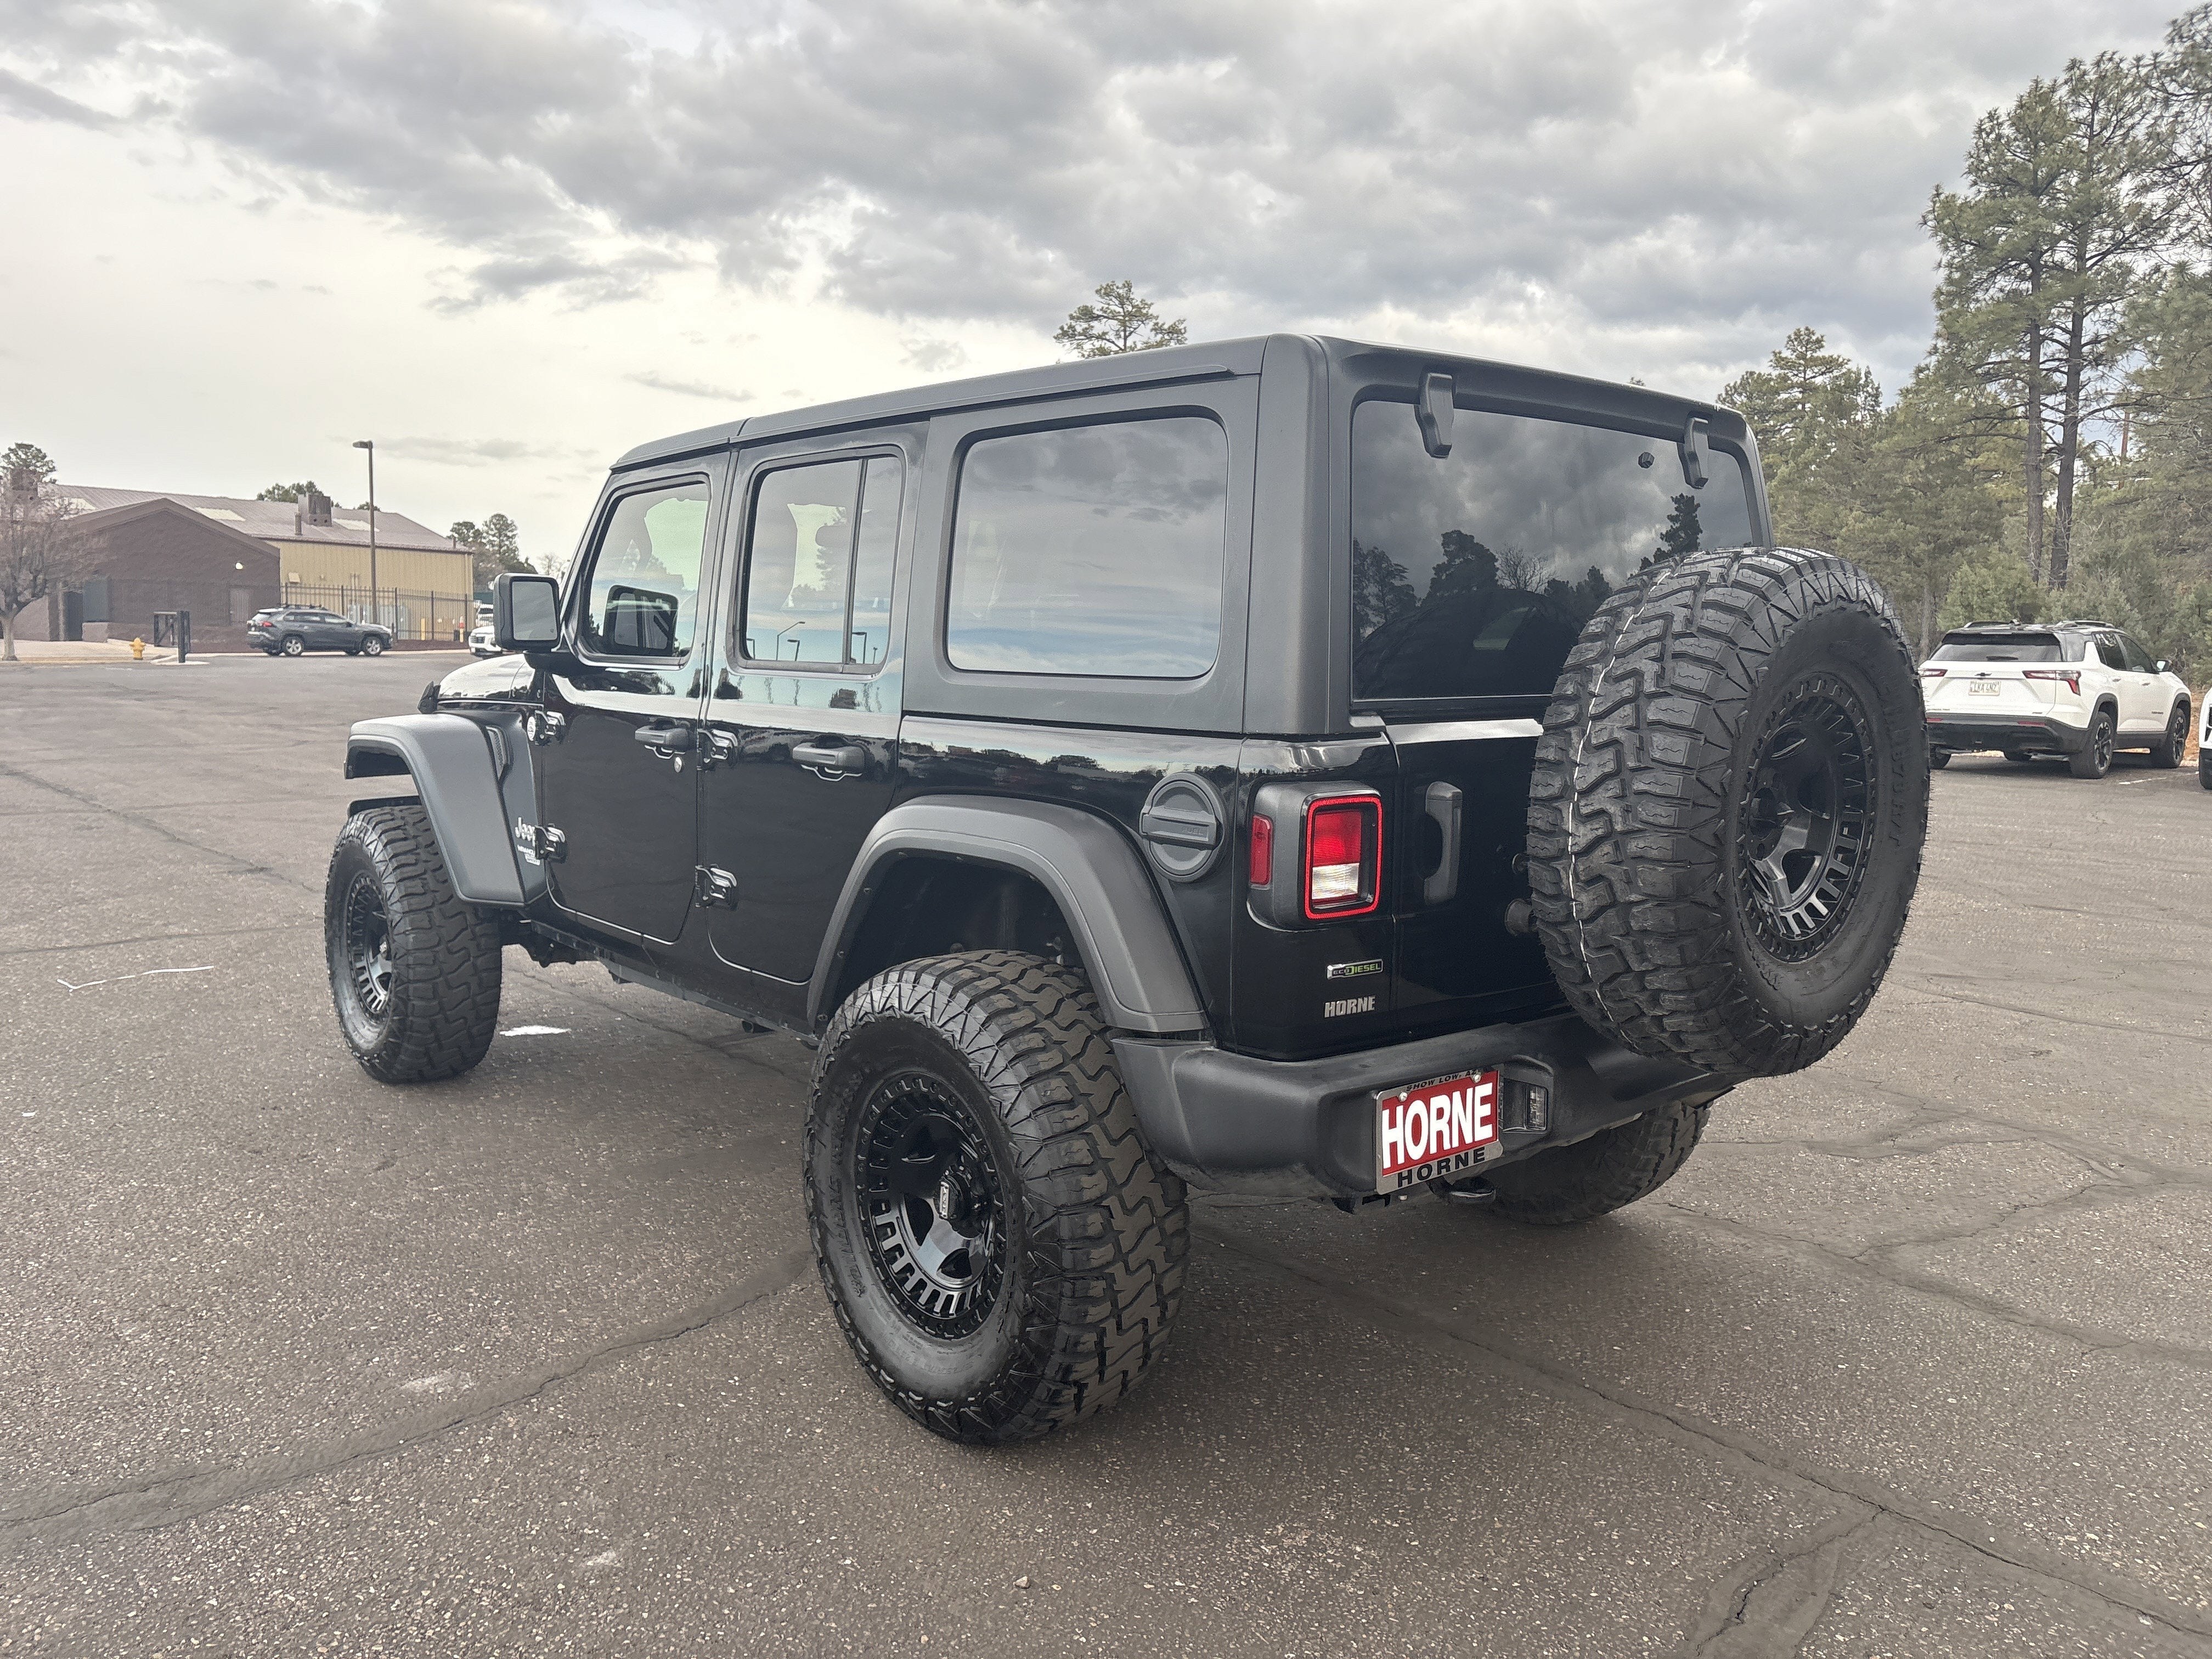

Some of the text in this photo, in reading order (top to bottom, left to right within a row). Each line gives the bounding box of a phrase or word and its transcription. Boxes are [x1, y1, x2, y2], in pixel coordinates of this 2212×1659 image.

[1181, 826, 1204, 836] FUEL
[1324, 996, 1376, 1018] HORNE
[1406, 1079, 1436, 1091] SHOW
[1438, 1074, 1462, 1083] LOW,
[1382, 1082, 1493, 1169] HORNE
[1397, 1147, 1485, 1188] HORNE
